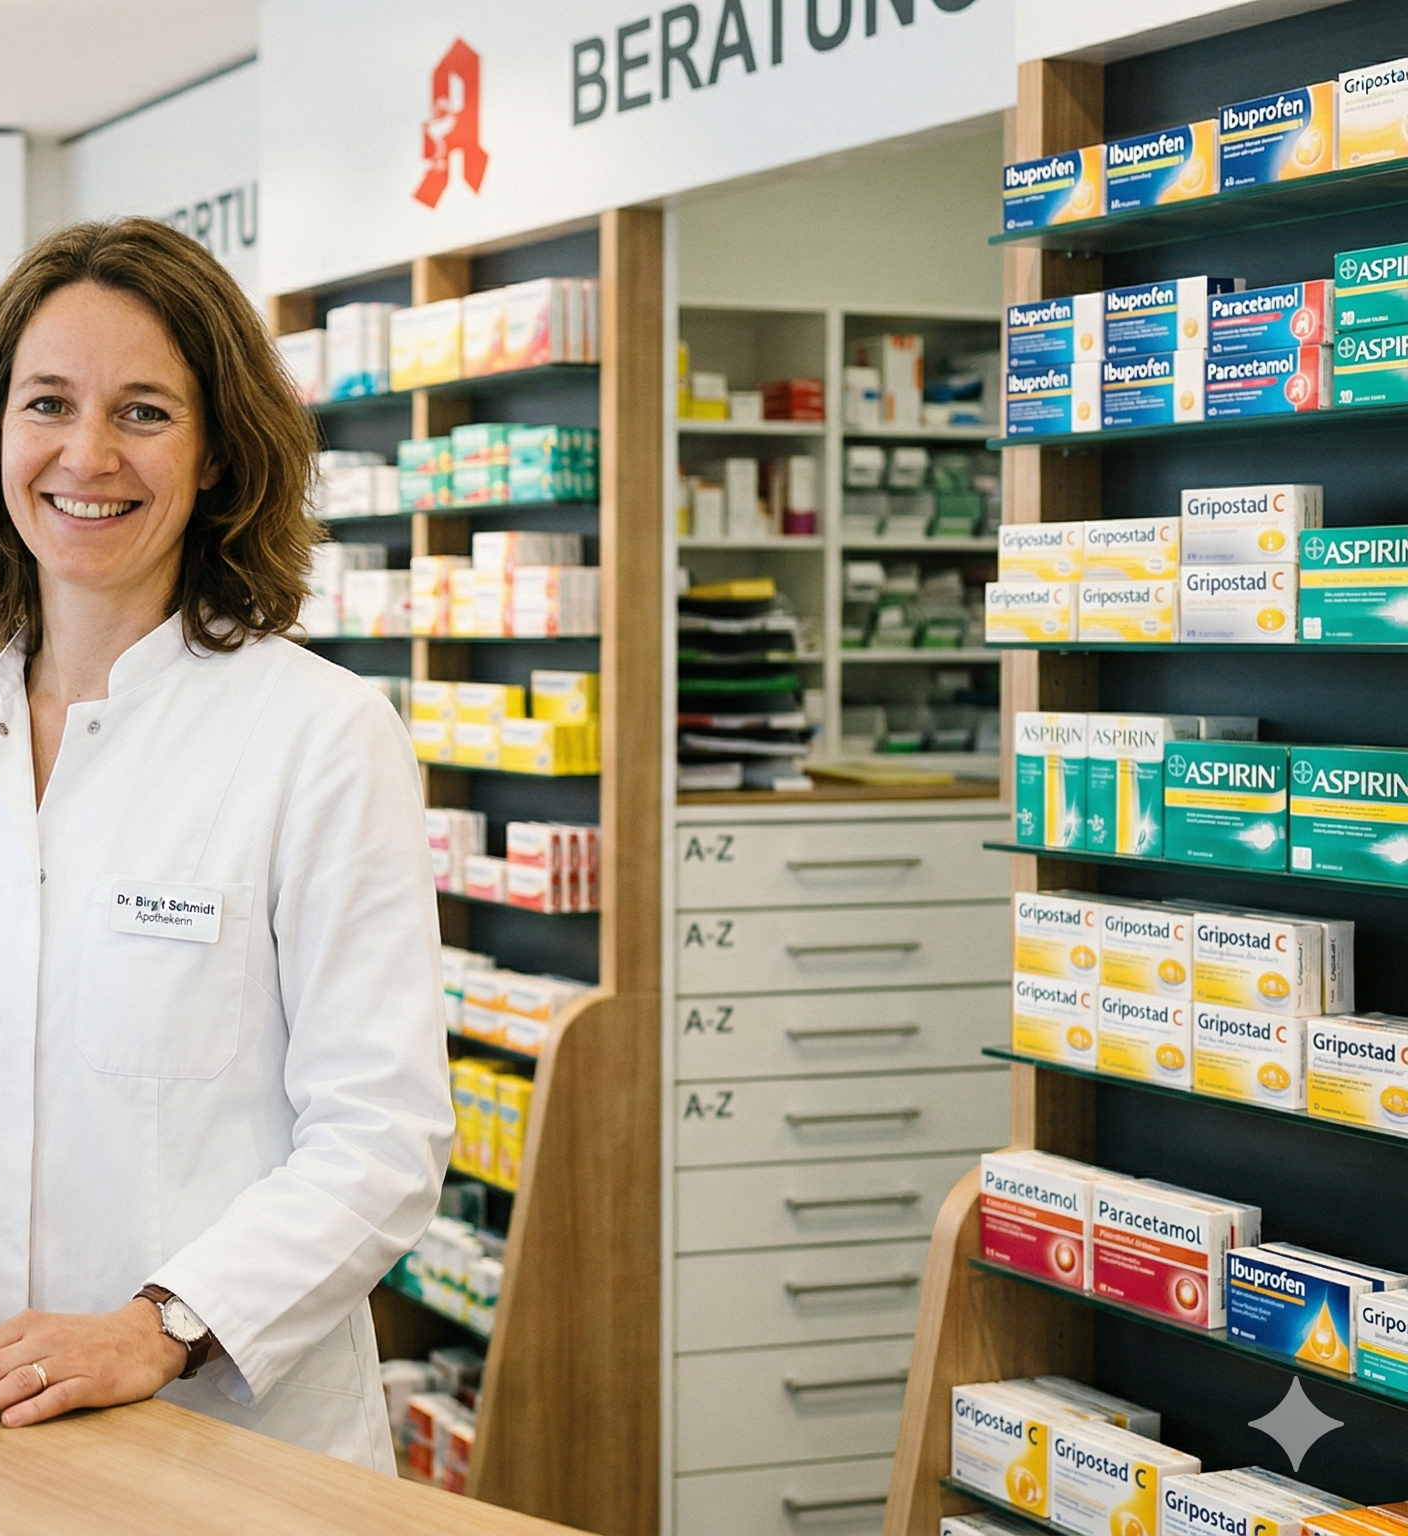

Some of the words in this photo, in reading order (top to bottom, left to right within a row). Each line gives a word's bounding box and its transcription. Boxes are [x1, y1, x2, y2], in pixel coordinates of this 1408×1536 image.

[572, 0, 980, 127] BERATU
[1223, 96, 1303, 130] Ibuprofen
[1109, 134, 1184, 165] Ibuprofen
[1006, 158, 1074, 188] Ibuprofen
[1356, 255, 1408, 284] ASPI
[1108, 286, 1173, 312] Ibuprofen
[1212, 287, 1298, 318] Paracetamol
[1010, 302, 1071, 327] Ibuprofen
[1104, 357, 1169, 383] Ibuprofen
[1207, 353, 1293, 381] Paracetamol
[1008, 369, 1068, 394] Ibuprofen
[1187, 494, 1268, 520] Gripostad
[1273, 493, 1285, 512] C
[1066, 530, 1076, 545] C
[1159, 525, 1170, 542] C
[1053, 588, 1063, 604] C
[1154, 586, 1165, 603] C
[1186, 571, 1267, 596] Gripostad
[1272, 572, 1284, 590] C
[1020, 726, 1083, 745] ASPIRIN
[1093, 729, 1156, 748] ASPIRIN
[1184, 761, 1275, 789] ASPIRIN
[684, 834, 735, 863] A-Z
[117, 894, 132, 906] Dr.
[168, 900, 215, 915] Schmidt
[1019, 903, 1081, 925] Gripostad
[1084, 911, 1094, 927] C
[685, 920, 734, 948] A-Z
[1105, 916, 1170, 938] Gripostad
[1173, 925, 1184, 941] C
[1197, 925, 1270, 950] Gripostad
[1275, 934, 1287, 952] C
[1017, 981, 1076, 1005] Gripostad
[1081, 992, 1090, 1009] C
[684, 1006, 734, 1034] A-Z
[1102, 997, 1168, 1023] Gripostad
[1172, 1009, 1183, 1026] C
[1198, 1013, 1270, 1040] Gripostad
[1276, 1025, 1287, 1043] C
[1313, 1033, 1396, 1063] Gripostad
[684, 1090, 734, 1120] A-Z
[985, 1171, 1078, 1212] Paracetamol
[1099, 1200, 1202, 1245] Paracetamol
[1231, 1257, 1305, 1297] Ibuprofen
[1363, 1307, 1408, 1334] Gripo
[955, 1398, 1022, 1439] Gripostad
[1028, 1426, 1038, 1446] C
[1055, 1438, 1128, 1482] Gripostad
[1135, 1468, 1146, 1489] C
[1165, 1490, 1246, 1536] Gripostad
